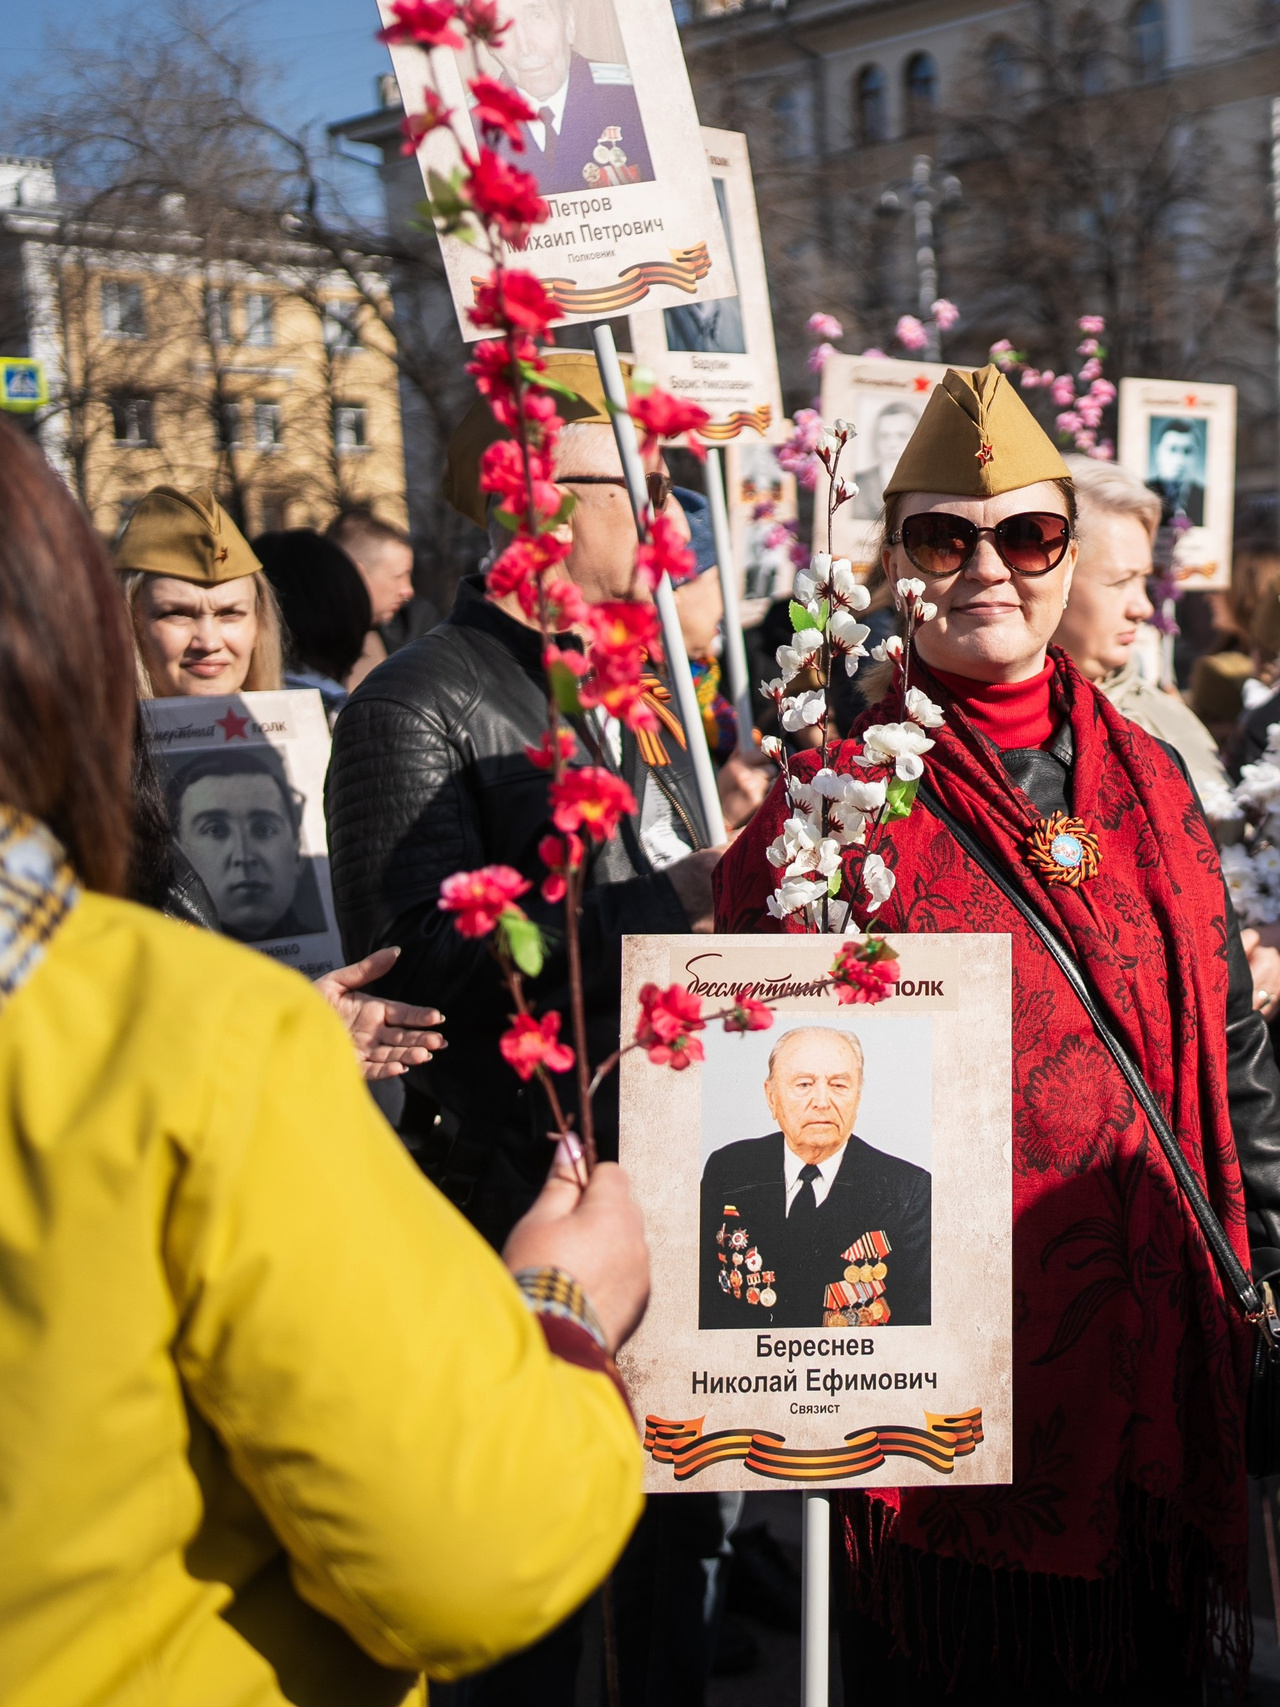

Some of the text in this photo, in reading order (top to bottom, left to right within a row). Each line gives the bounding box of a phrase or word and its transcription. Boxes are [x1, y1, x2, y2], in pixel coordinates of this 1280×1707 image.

[548, 197, 612, 218] Петров
[579, 218, 664, 242] Петрович
[567, 249, 616, 263] Полковник
[756, 1334, 875, 1362] Береснев
[692, 1368, 938, 1396] Николай Ефимович
[789, 1402, 841, 1414] Связист
